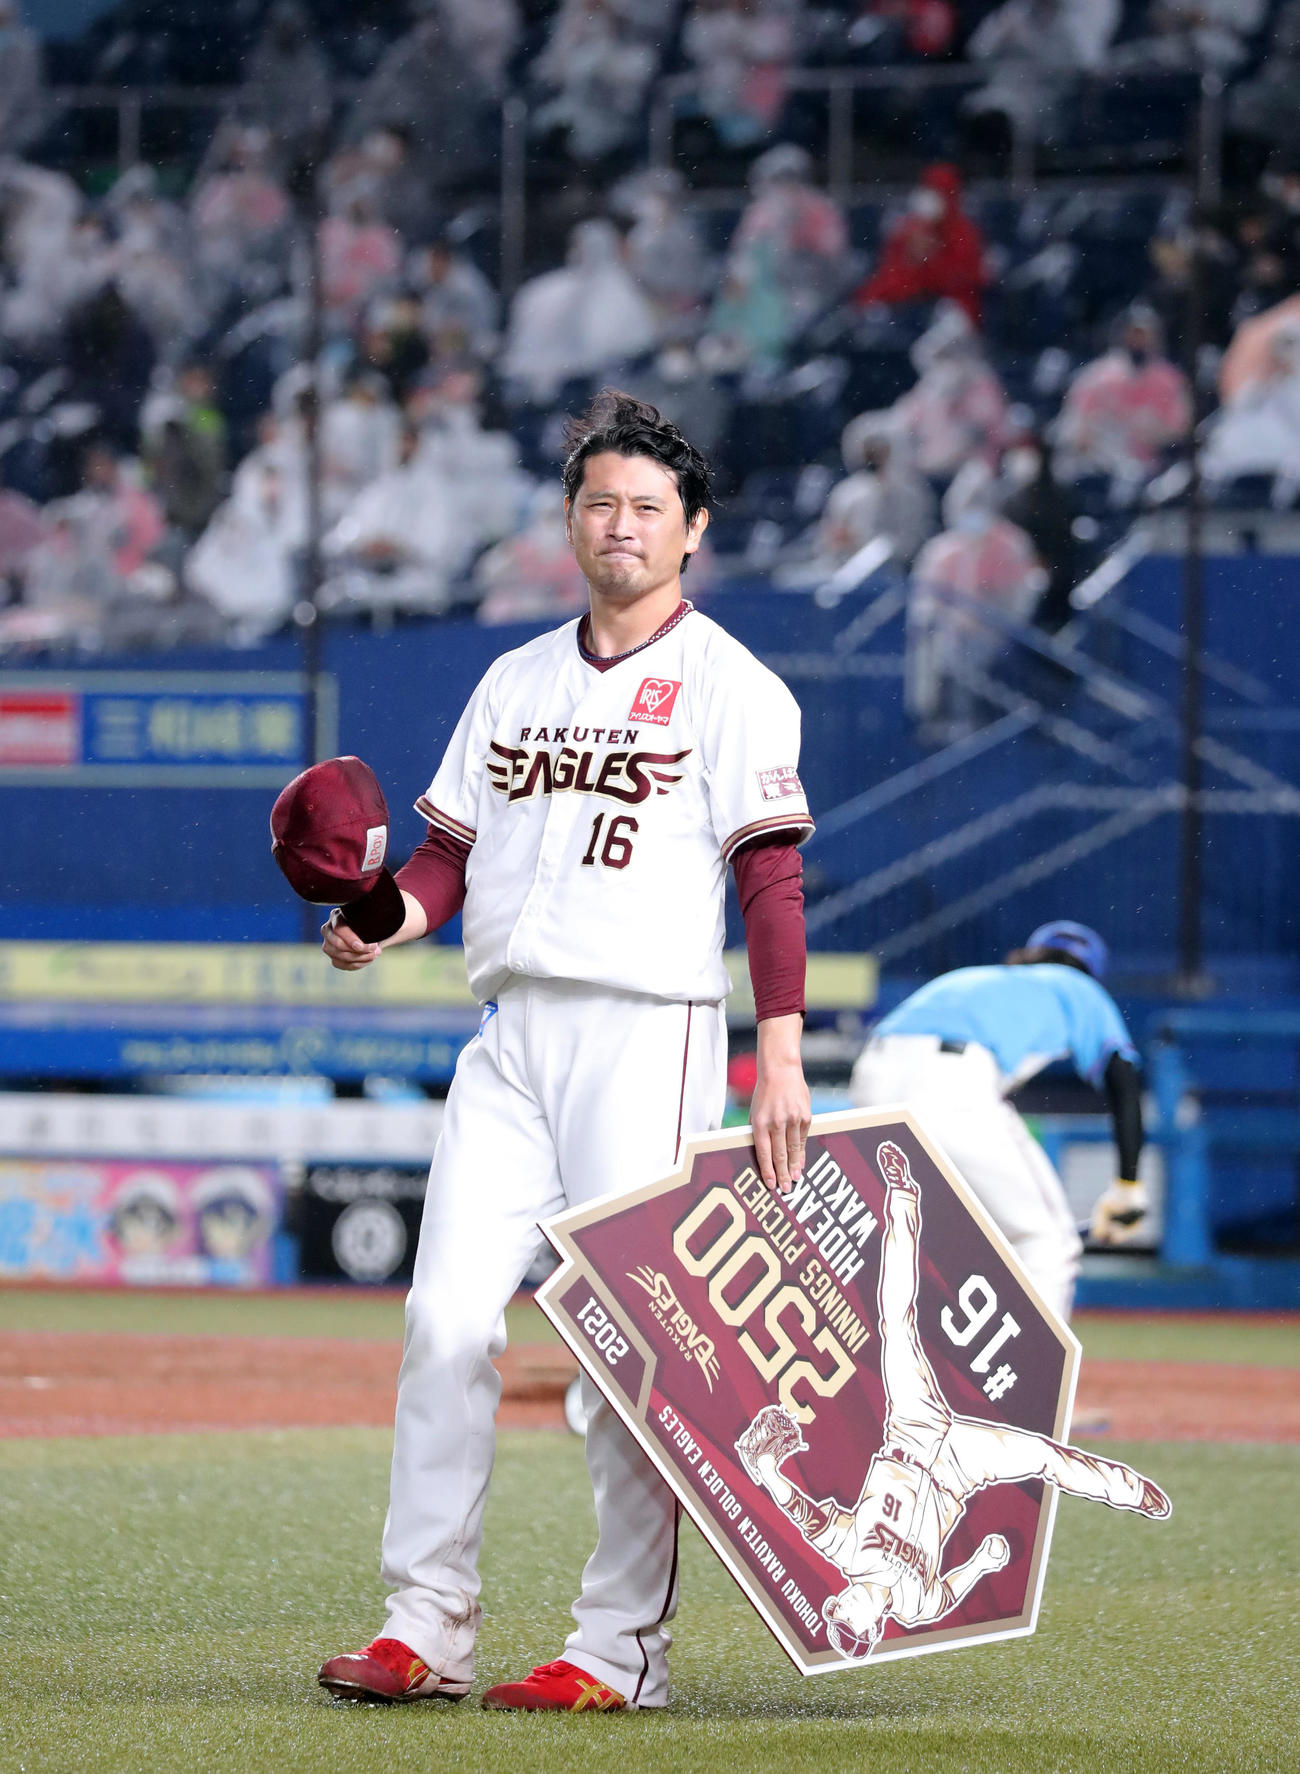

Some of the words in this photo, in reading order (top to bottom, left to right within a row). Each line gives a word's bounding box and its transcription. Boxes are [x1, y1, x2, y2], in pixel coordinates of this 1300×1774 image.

[639, 688, 663, 705] IRIS
[520, 726, 640, 744] RAKUTEN
[485, 739, 693, 808] EAGLES
[580, 812, 640, 870] 16
[733, 1166, 807, 1266] PITCHED
[775, 1172, 866, 1287] HIDEAK
[806, 1150, 879, 1249] WAKUI
[576, 1296, 630, 1365] 2021
[625, 1265, 721, 1394] EAGLES
[648, 1302, 693, 1362] RAKUTEN
[673, 1186, 857, 1425] 2500
[799, 1258, 871, 1355] INNINGS
[658, 1405, 703, 1466] EAGLES
[697, 1459, 742, 1521] GOLDEN
[882, 1492, 903, 1522] 16
[737, 1515, 787, 1583] RAKUTEN
[860, 1520, 931, 1597] EAGLES
[781, 1577, 824, 1638] TOHOKU
